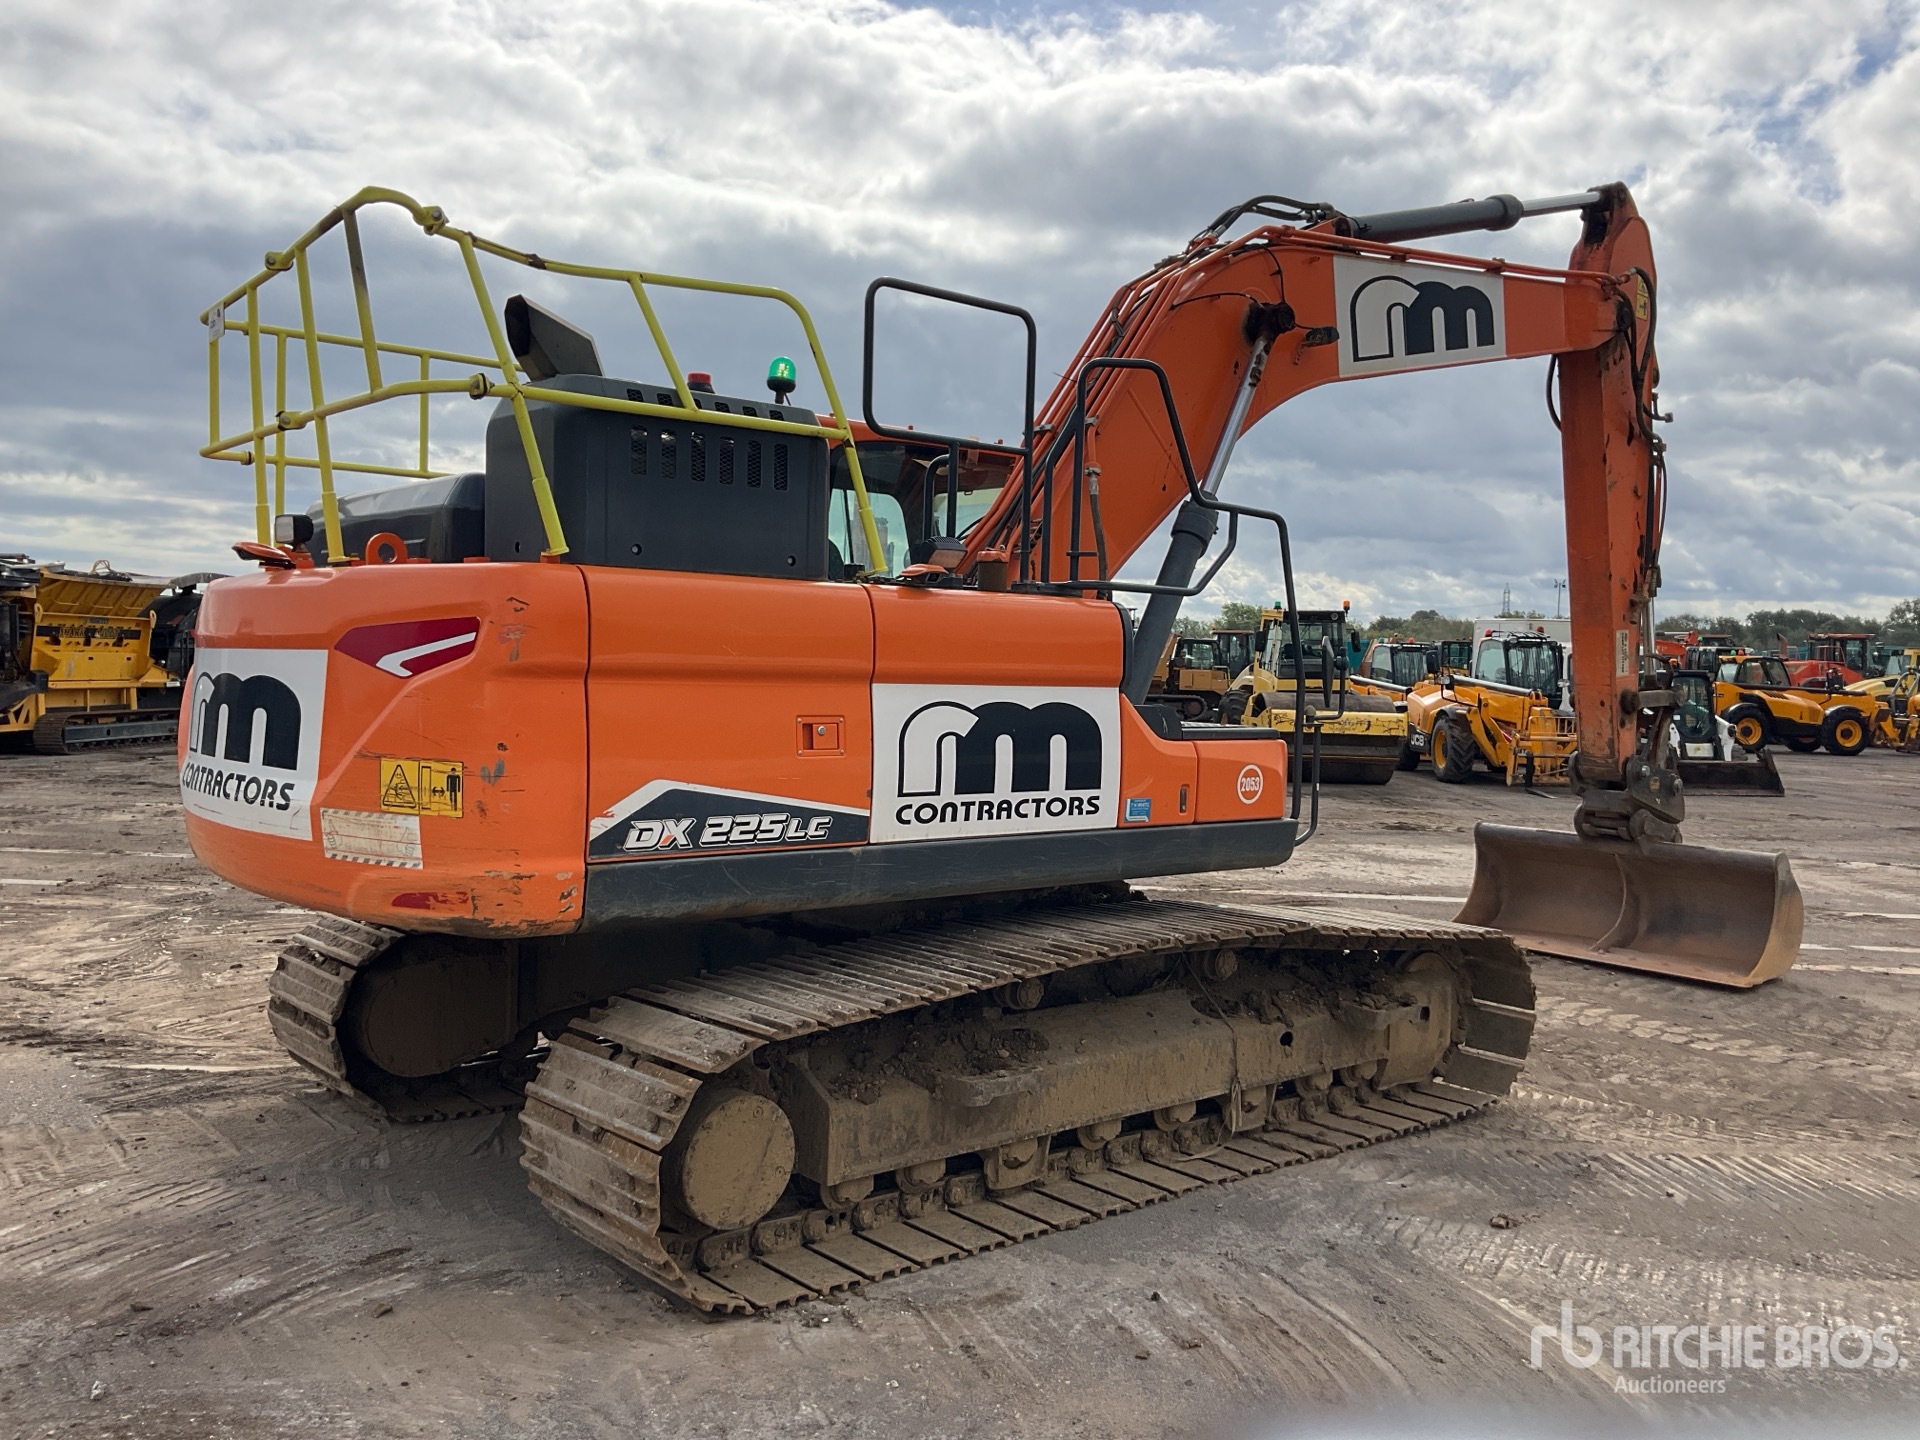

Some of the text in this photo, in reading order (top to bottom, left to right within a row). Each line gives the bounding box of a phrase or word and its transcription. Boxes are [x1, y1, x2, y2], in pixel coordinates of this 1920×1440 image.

[1410, 734, 1425, 747] JCB
[182, 761, 296, 811] CONTRACTORS
[1241, 776, 1260, 792] 2053
[895, 795, 1100, 826] CONTRACTORS
[623, 816, 697, 851] DX
